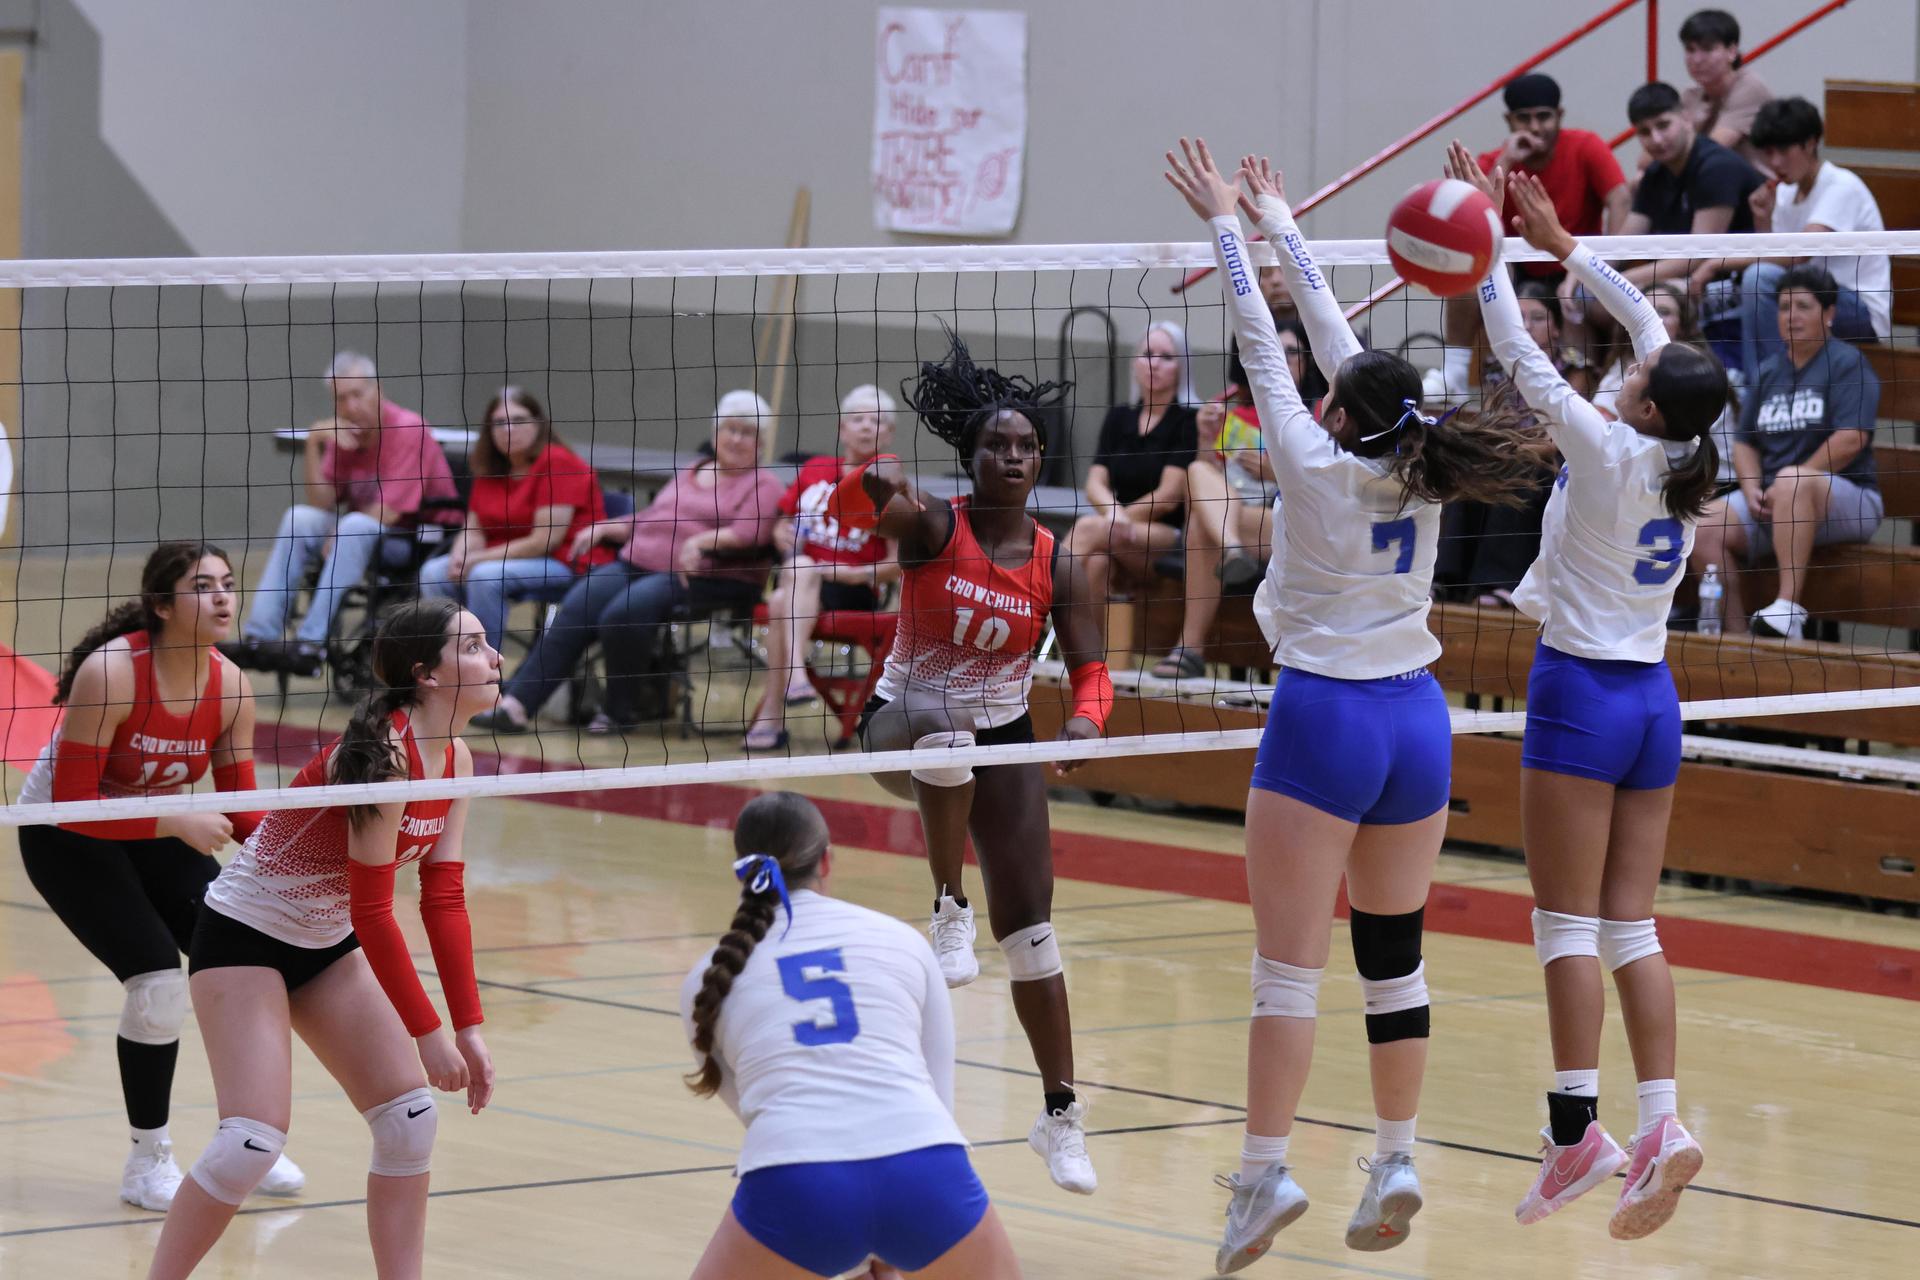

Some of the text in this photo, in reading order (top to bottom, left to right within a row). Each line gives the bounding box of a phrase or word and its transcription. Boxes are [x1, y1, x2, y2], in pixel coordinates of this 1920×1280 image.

[1219, 233, 1252, 297] COYOTES
[1284, 233, 1326, 291] COYOTES
[1588, 255, 1643, 304] COYOTES
[1370, 515, 1416, 575] 7
[1632, 516, 1685, 586] 3
[944, 574, 1032, 618] CHOWCHILLA
[952, 606, 1011, 652] 10
[128, 732, 207, 756] CHOWCHILLA
[135, 760, 189, 785] 12
[775, 946, 861, 1047] 5
